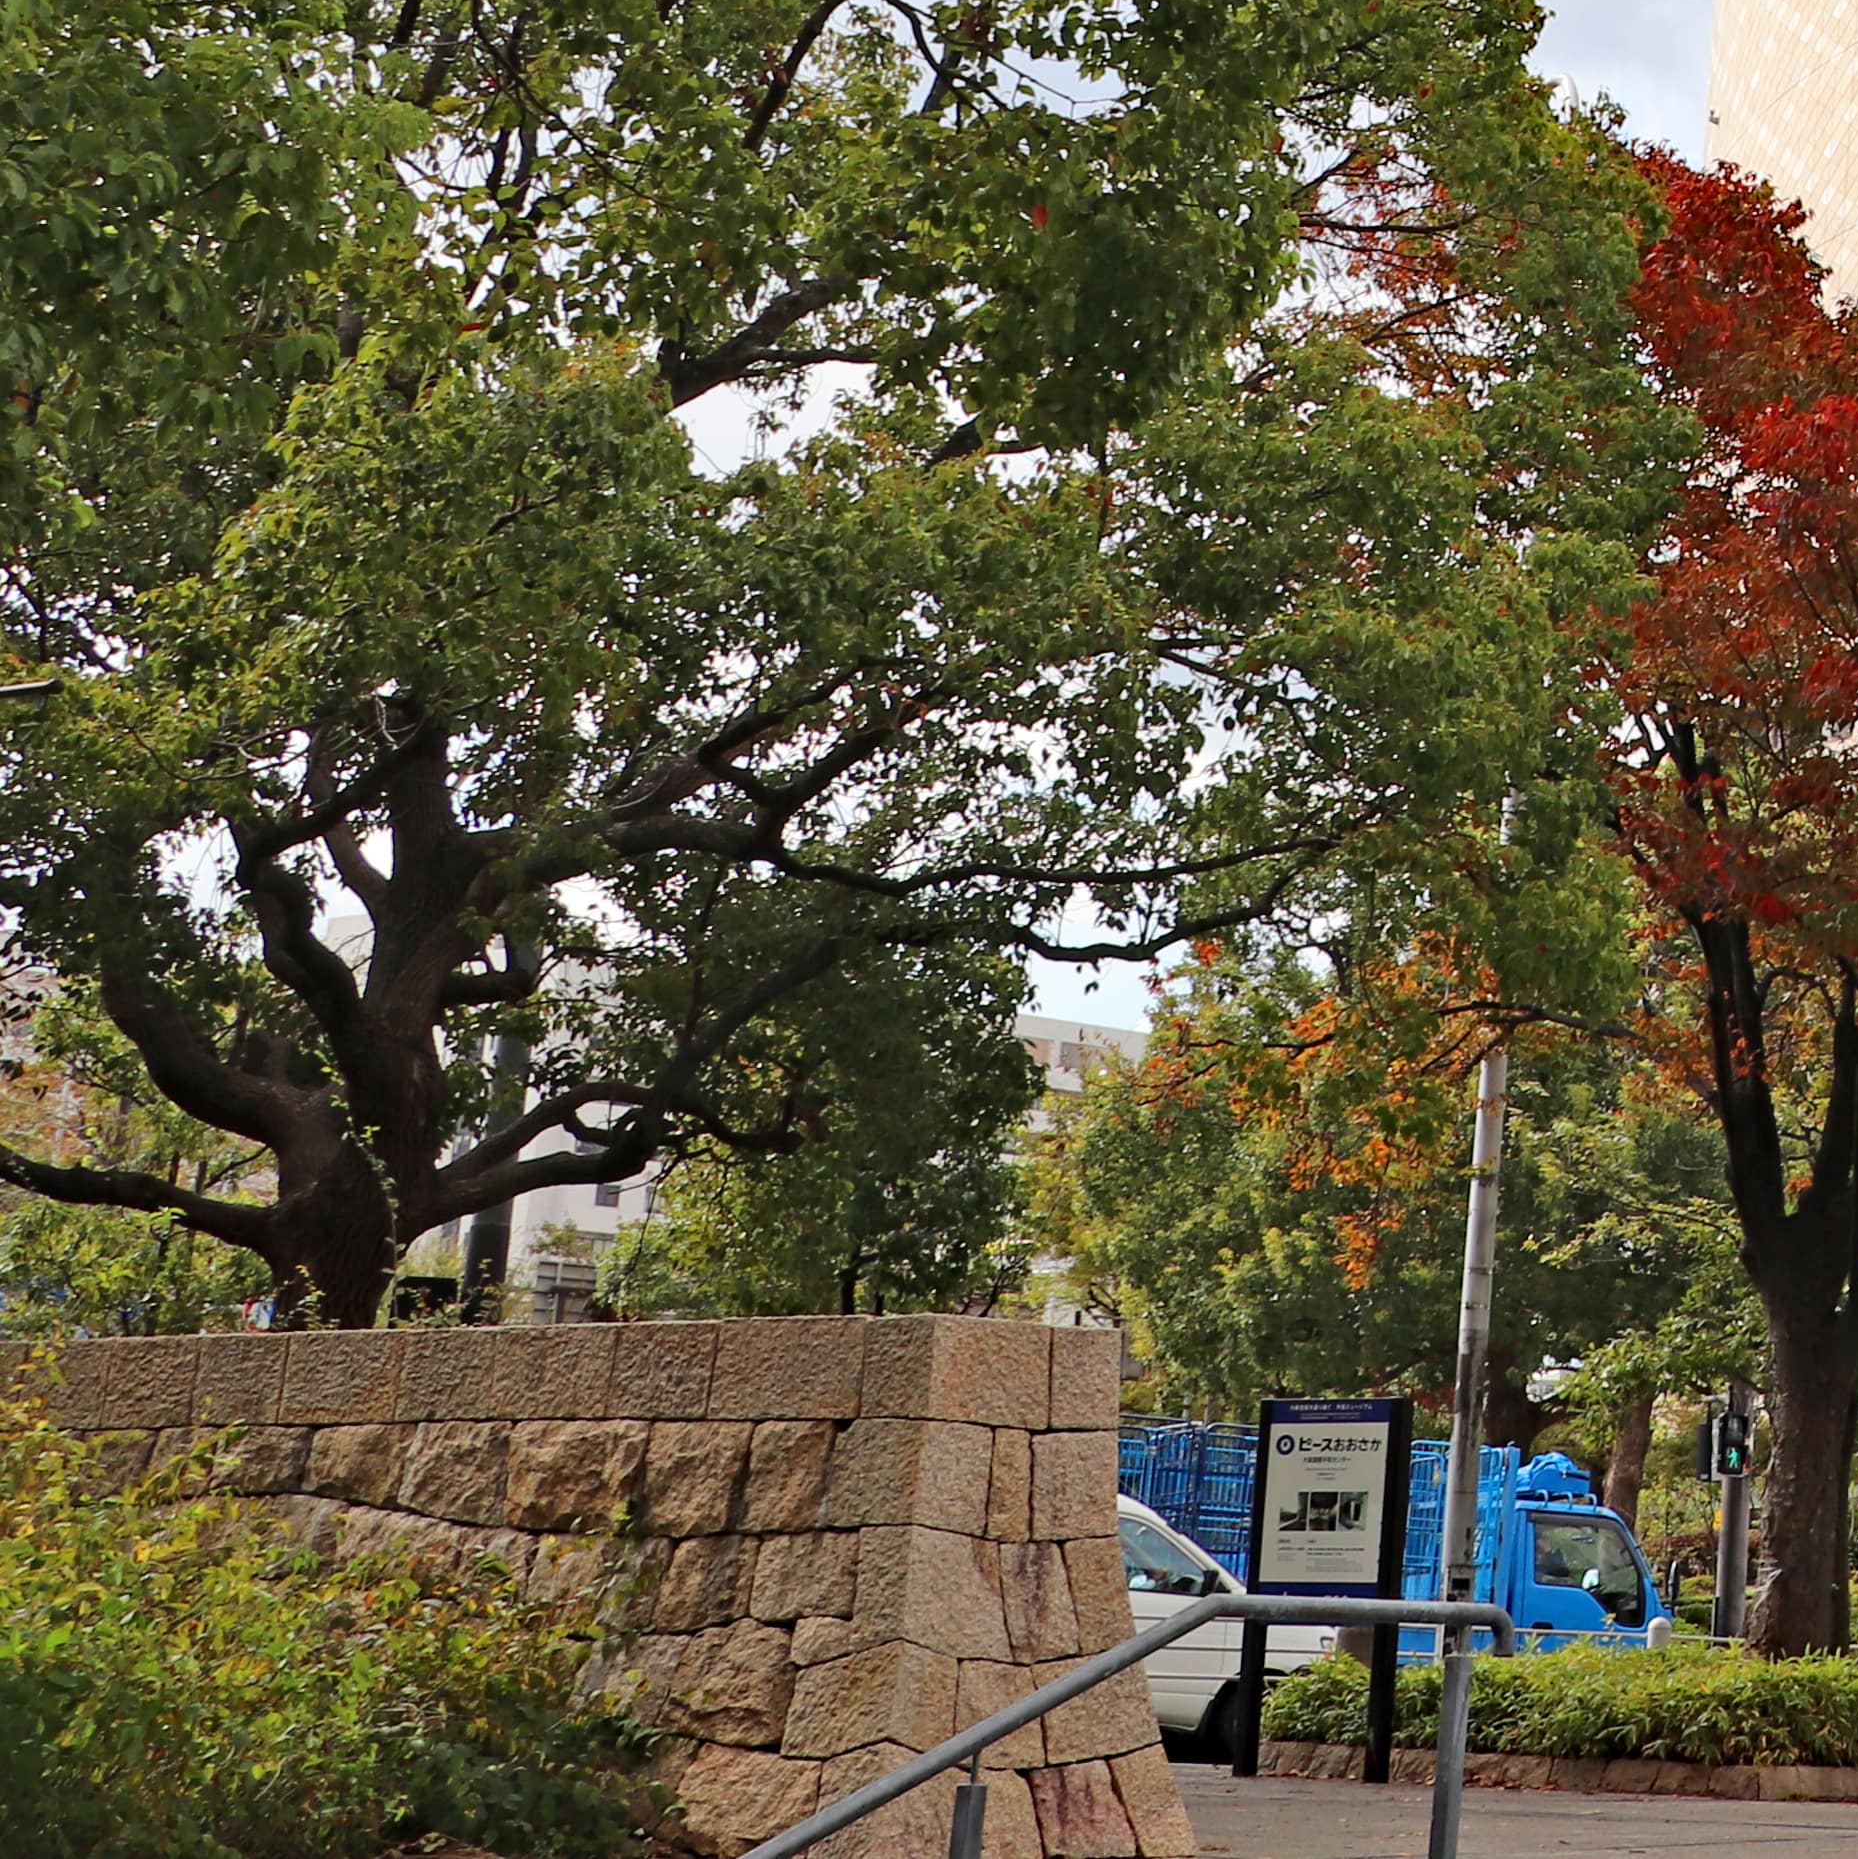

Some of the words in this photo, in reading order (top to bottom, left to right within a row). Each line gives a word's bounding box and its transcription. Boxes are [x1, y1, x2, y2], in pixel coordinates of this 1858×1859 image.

[1298, 1437, 1382, 1452] ピースおおさか
